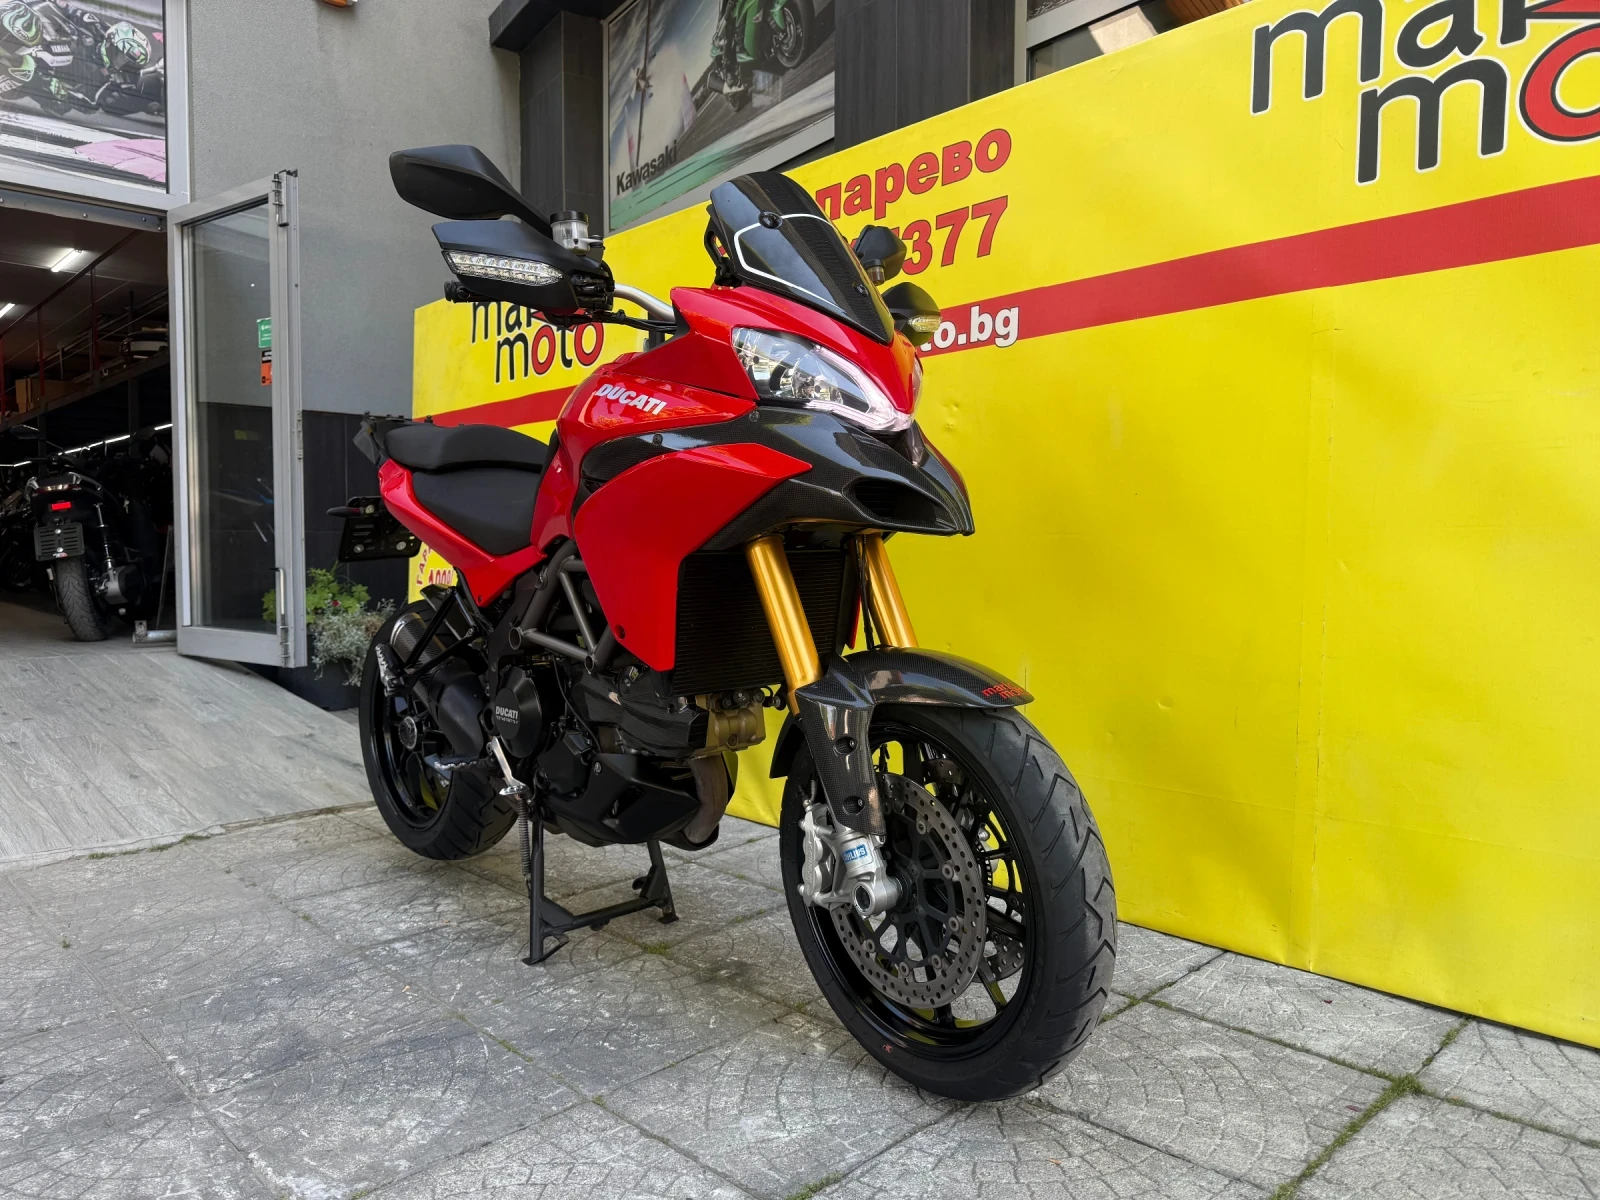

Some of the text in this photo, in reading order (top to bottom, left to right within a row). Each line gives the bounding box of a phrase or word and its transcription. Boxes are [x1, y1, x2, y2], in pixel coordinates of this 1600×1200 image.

[616, 139, 677, 196] Kawasaki
[891, 195, 1008, 275] 377
[495, 321, 605, 384] moto
[919, 304, 1019, 353] o.bg
[595, 383, 667, 415] DUCATI
[495, 705, 519, 720] DUCATI
